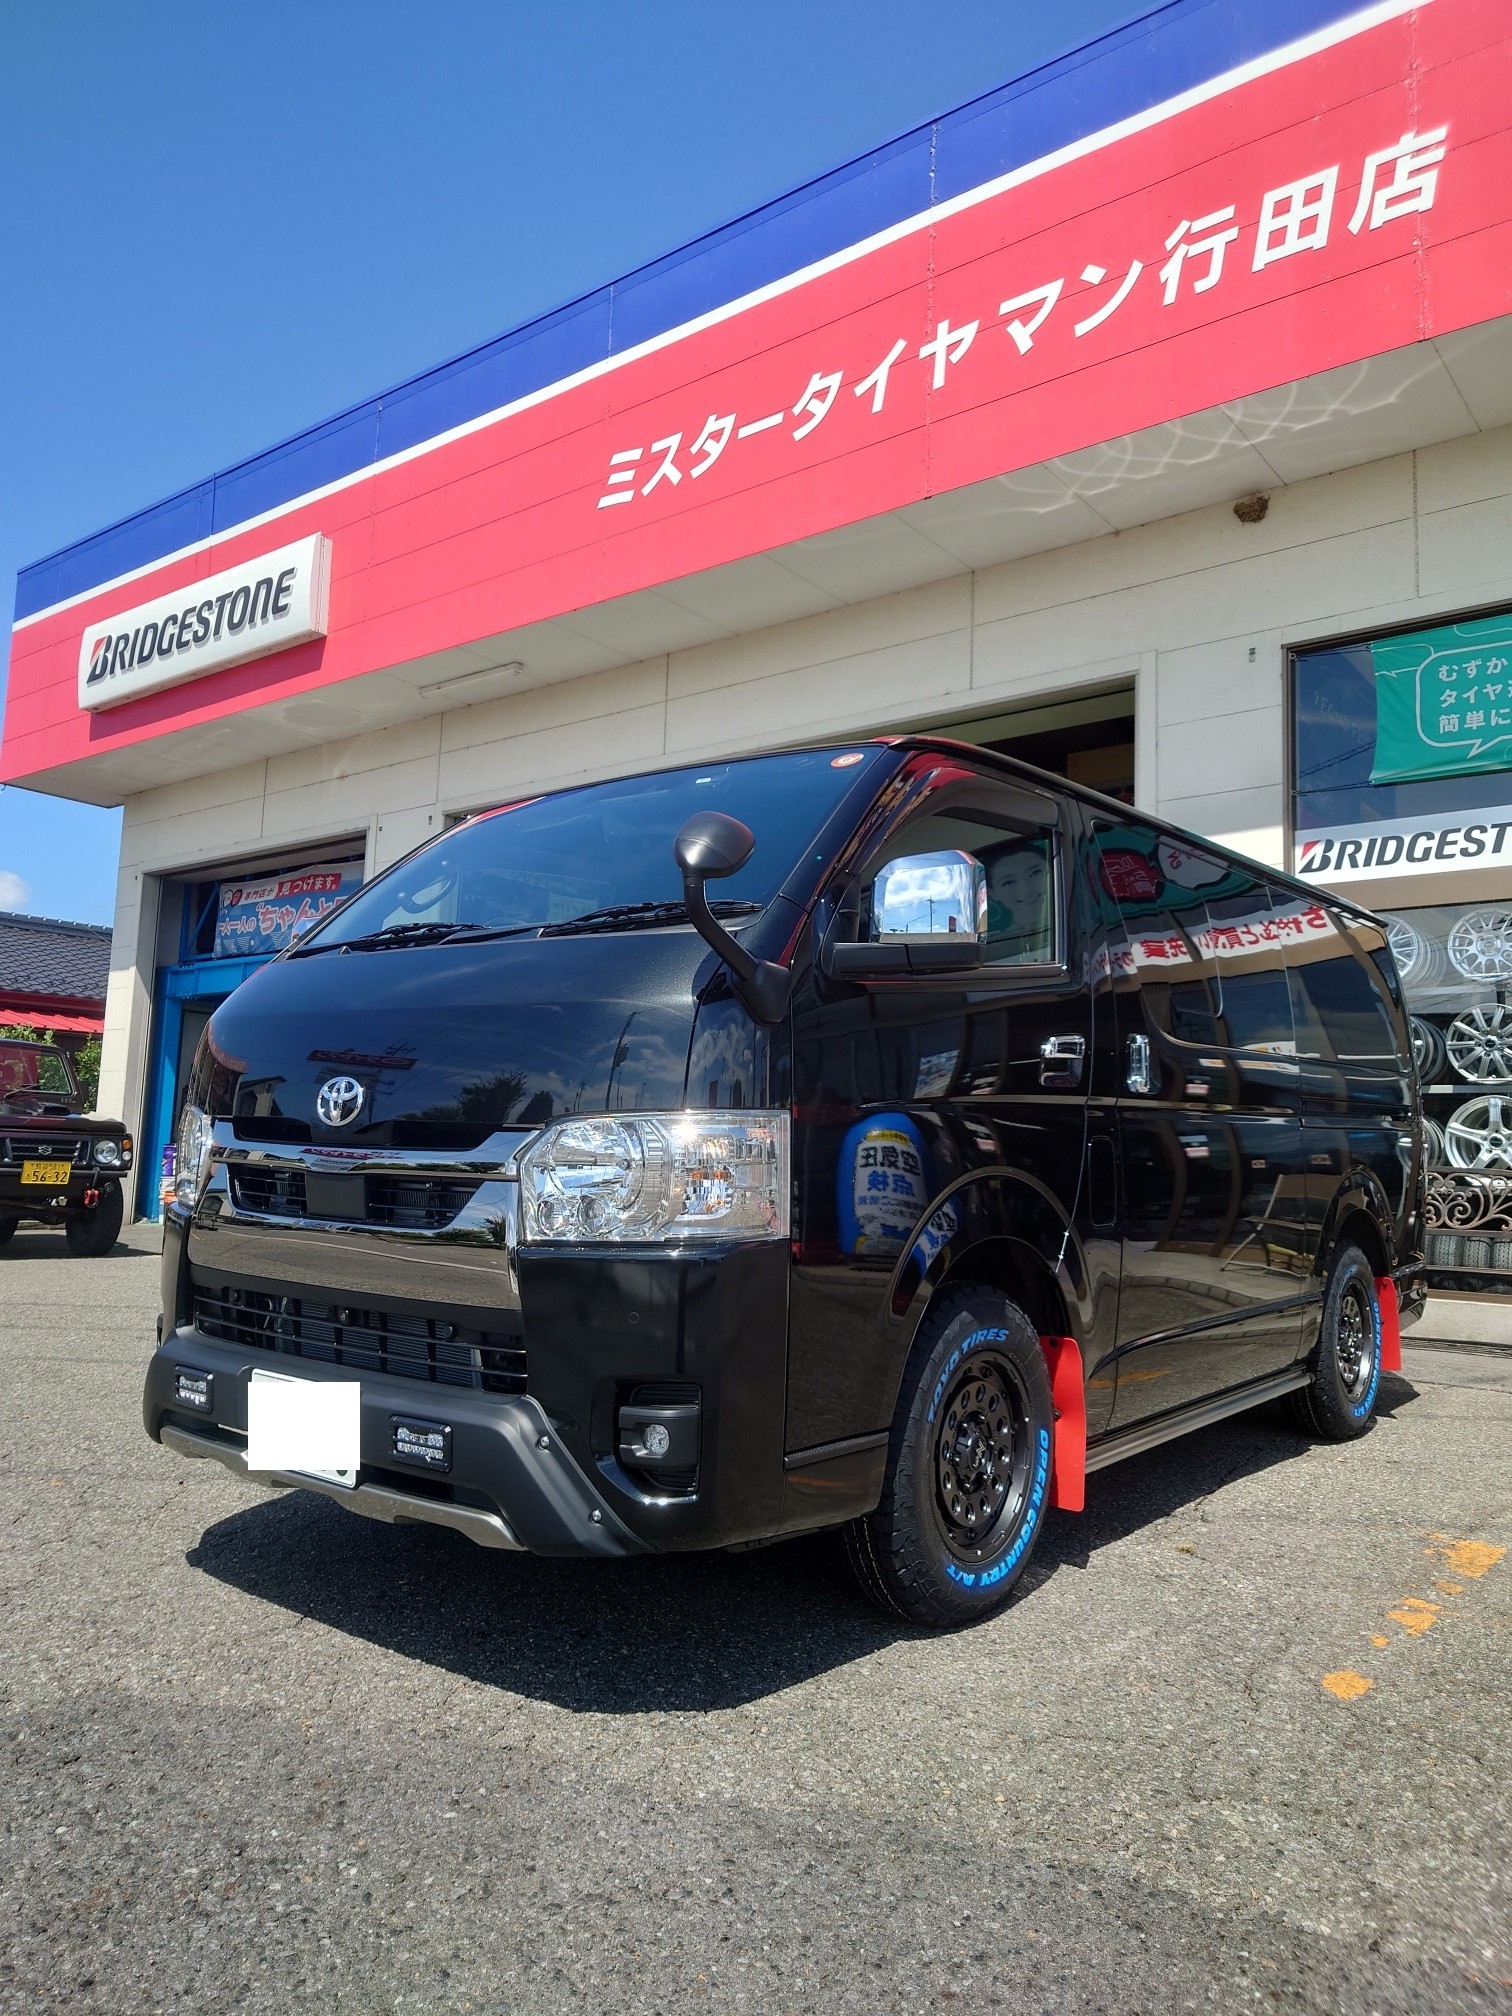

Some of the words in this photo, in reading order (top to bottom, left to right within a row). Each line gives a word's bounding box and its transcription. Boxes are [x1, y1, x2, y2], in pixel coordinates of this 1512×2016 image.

[597, 126, 1448, 509] ミスタータイヤマン行田店
[86, 566, 296, 684] BRIDGESTONE
[1438, 657, 1508, 681] むずか
[1440, 680, 1512, 707] タイヤ
[1439, 708, 1511, 734] 簡単に
[31, 1170, 67, 1183] 56-32
[960, 1327, 1009, 1352] TIRES
[1032, 1429, 1050, 1508] OPEN
[980, 1509, 1039, 1587] COUNTRY
[946, 1564, 976, 1587] A/T
